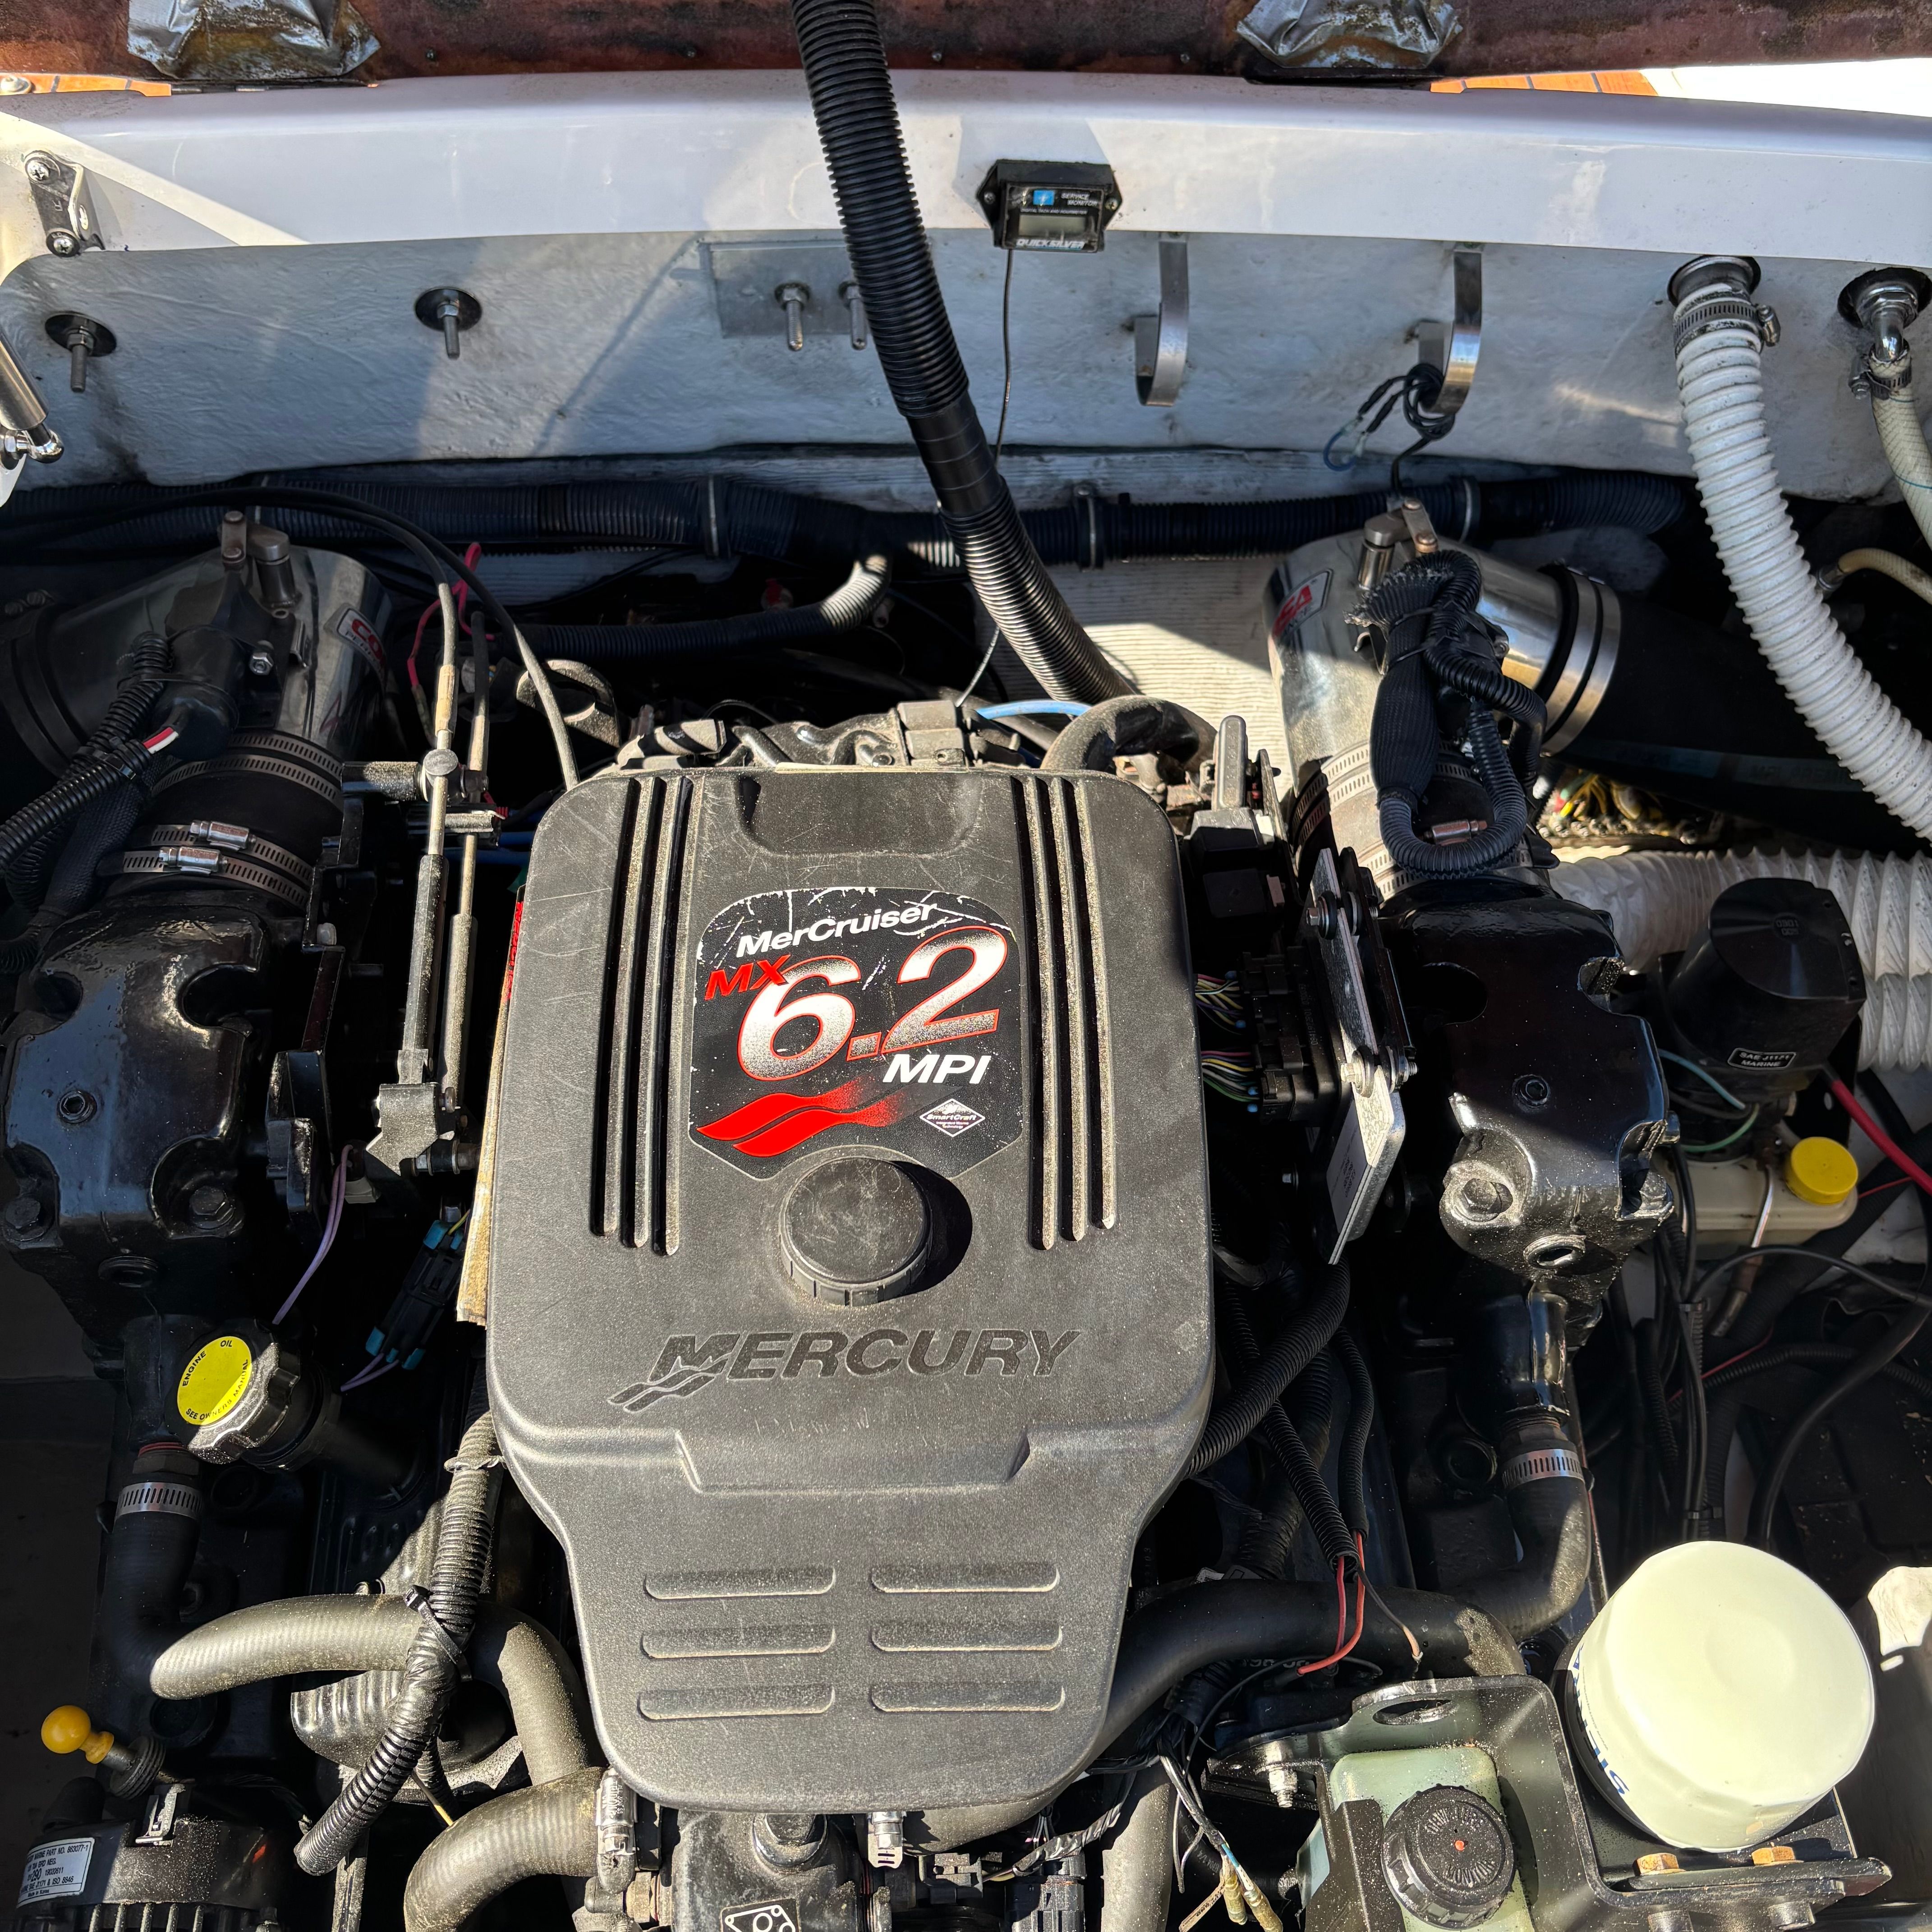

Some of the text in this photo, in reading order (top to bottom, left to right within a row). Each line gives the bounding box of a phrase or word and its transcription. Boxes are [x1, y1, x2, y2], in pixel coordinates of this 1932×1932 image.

[1016, 238, 1085, 248] QUICKSILVER
[736, 903, 938, 958] MerCruiser
[704, 925, 1008, 1082] MX 6.2
[883, 1053, 991, 1085] MPI
[182, 1351, 207, 1386] ENGINE
[648, 1329, 1081, 1381] MERCURY
[186, 1408, 198, 1419] SEE
[233, 1359, 248, 1397] MANUAL
[46, 1849, 56, 1857] PART
